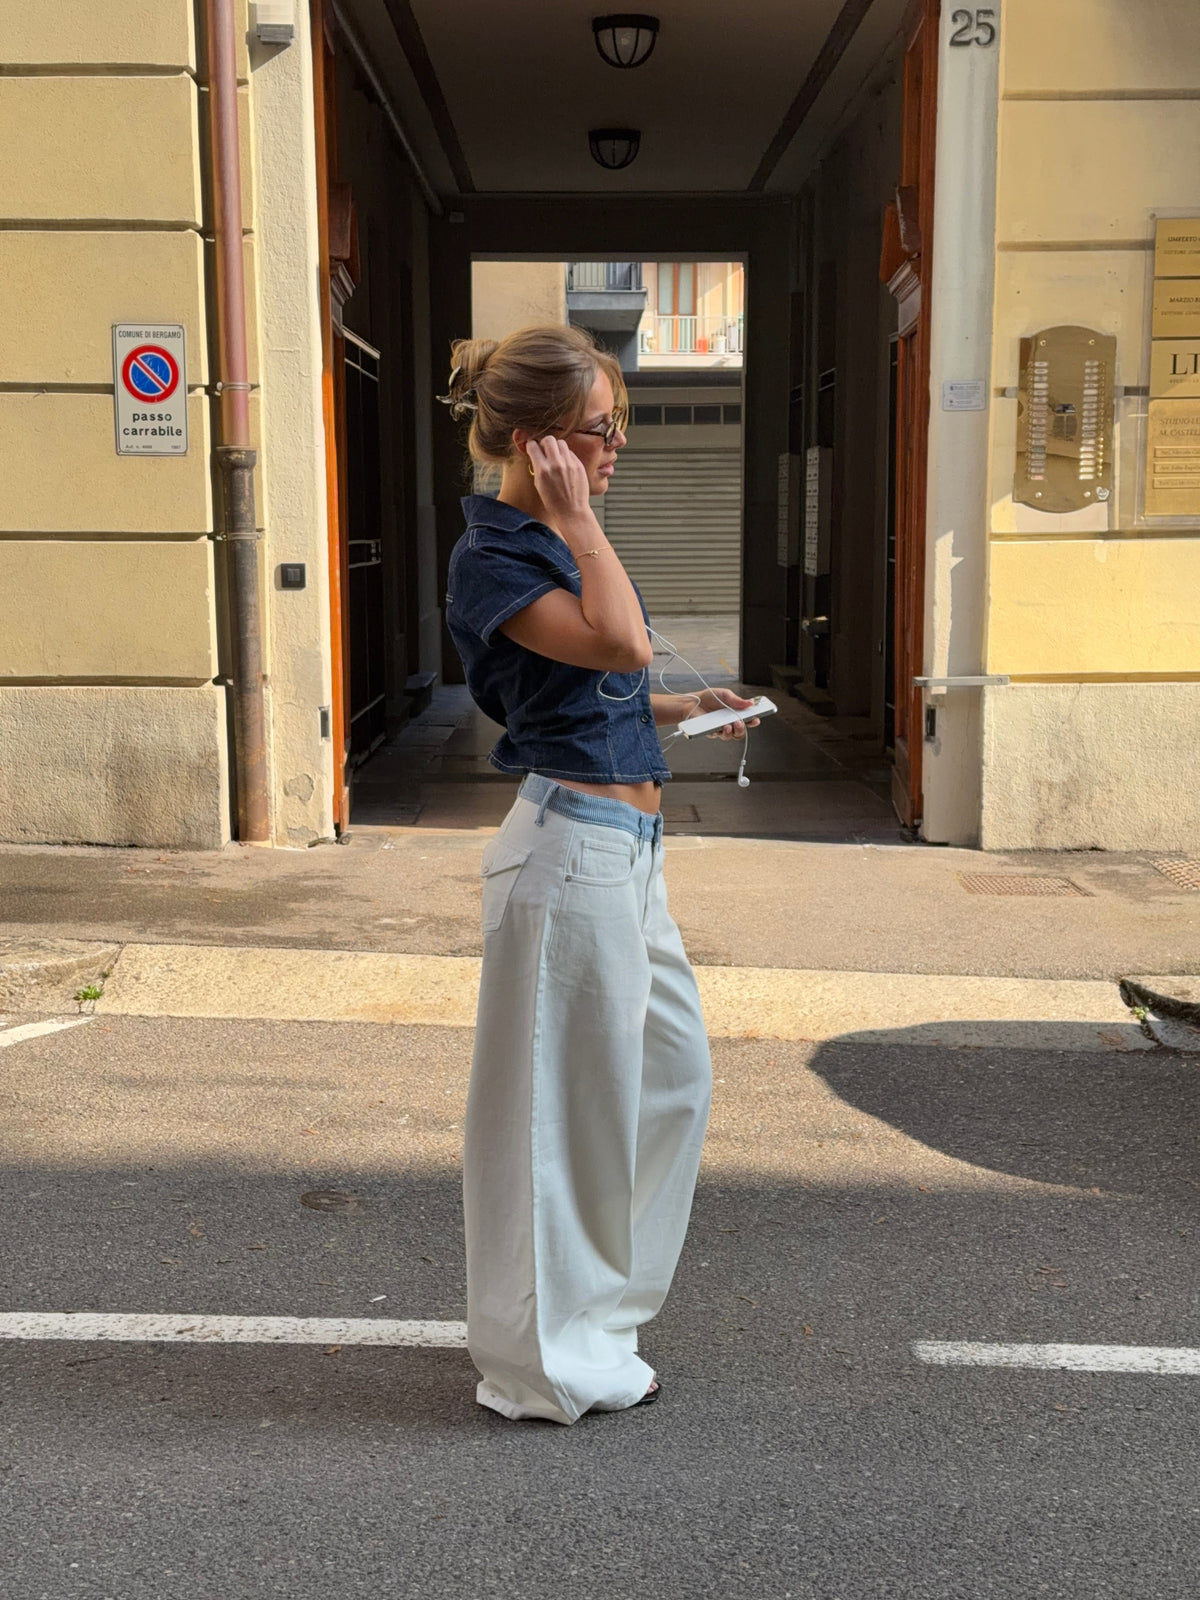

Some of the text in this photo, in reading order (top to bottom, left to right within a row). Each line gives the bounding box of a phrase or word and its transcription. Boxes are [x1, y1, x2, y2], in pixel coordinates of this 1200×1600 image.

[950, 8, 996, 48] 25
[118, 330, 182, 339] COMUNE DI BERGAMO
[132, 412, 173, 423] passo
[122, 425, 183, 437] carrabile
